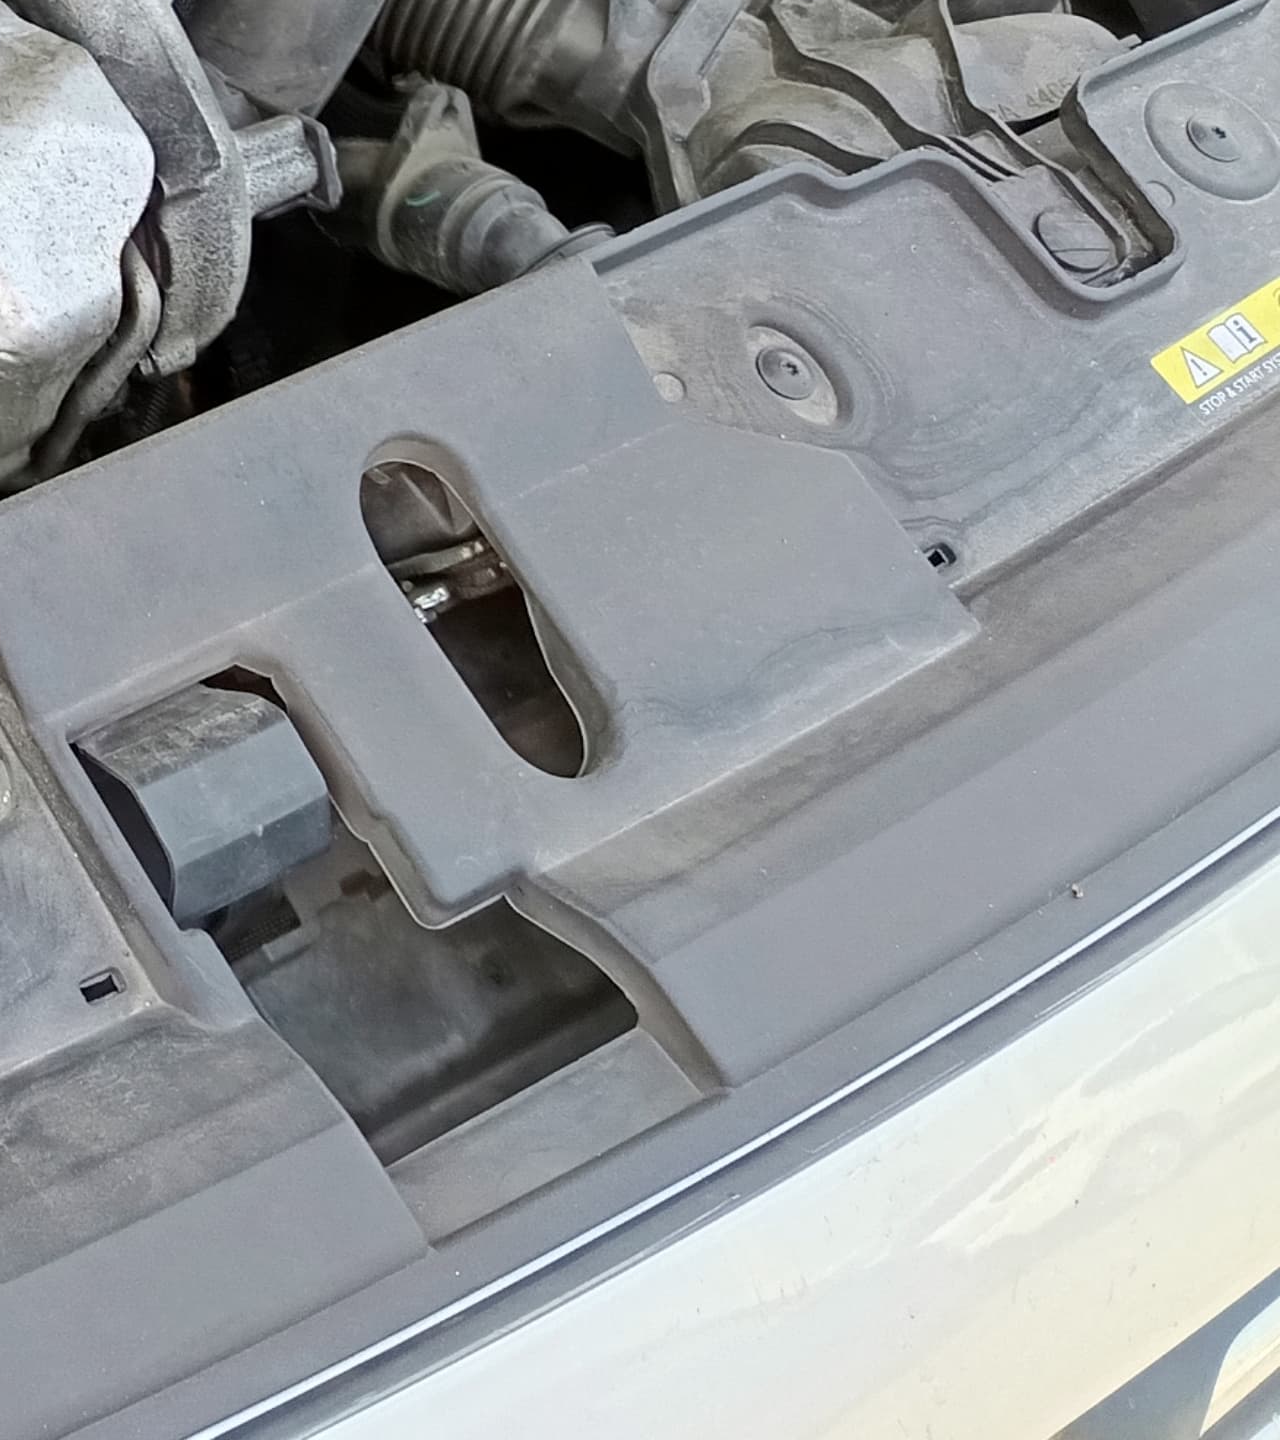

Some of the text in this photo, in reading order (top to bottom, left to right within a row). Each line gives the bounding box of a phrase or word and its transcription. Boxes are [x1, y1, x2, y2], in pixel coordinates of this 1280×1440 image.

[1199, 392, 1226, 416] STOP
[1226, 385, 1238, 400] &
[1234, 366, 1265, 393] START
